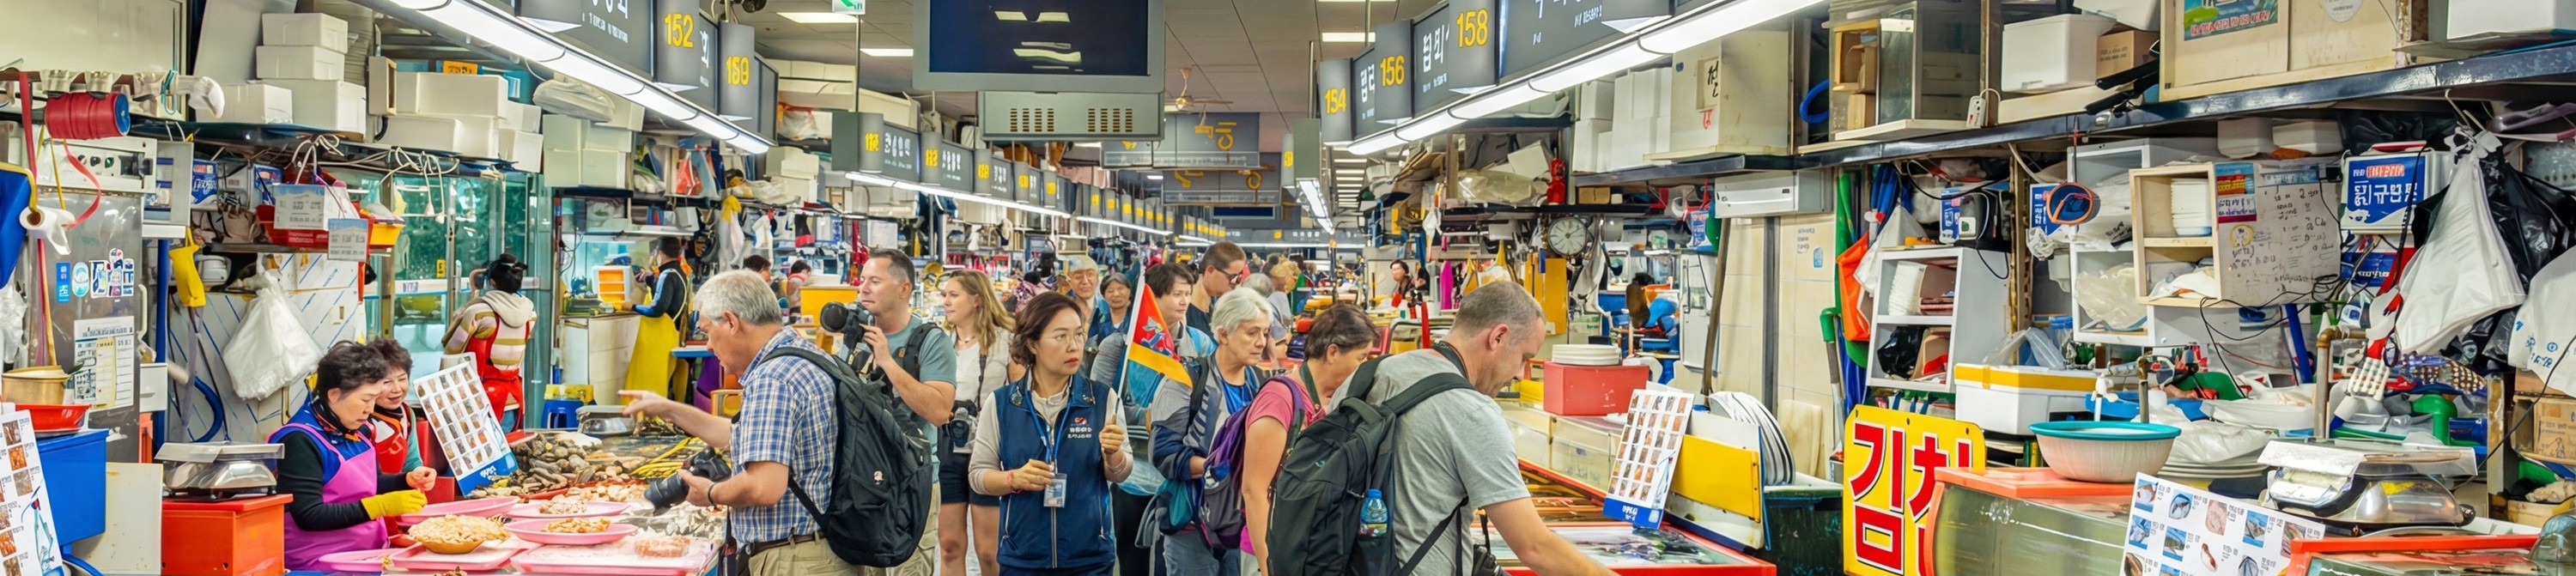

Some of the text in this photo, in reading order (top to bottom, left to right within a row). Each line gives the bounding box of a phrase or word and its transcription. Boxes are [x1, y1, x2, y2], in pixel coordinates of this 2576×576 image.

[665, 13, 694, 48] 152
[1456, 9, 1489, 48] 158
[1380, 55, 1406, 87] 156
[1325, 88, 1347, 114] 154
